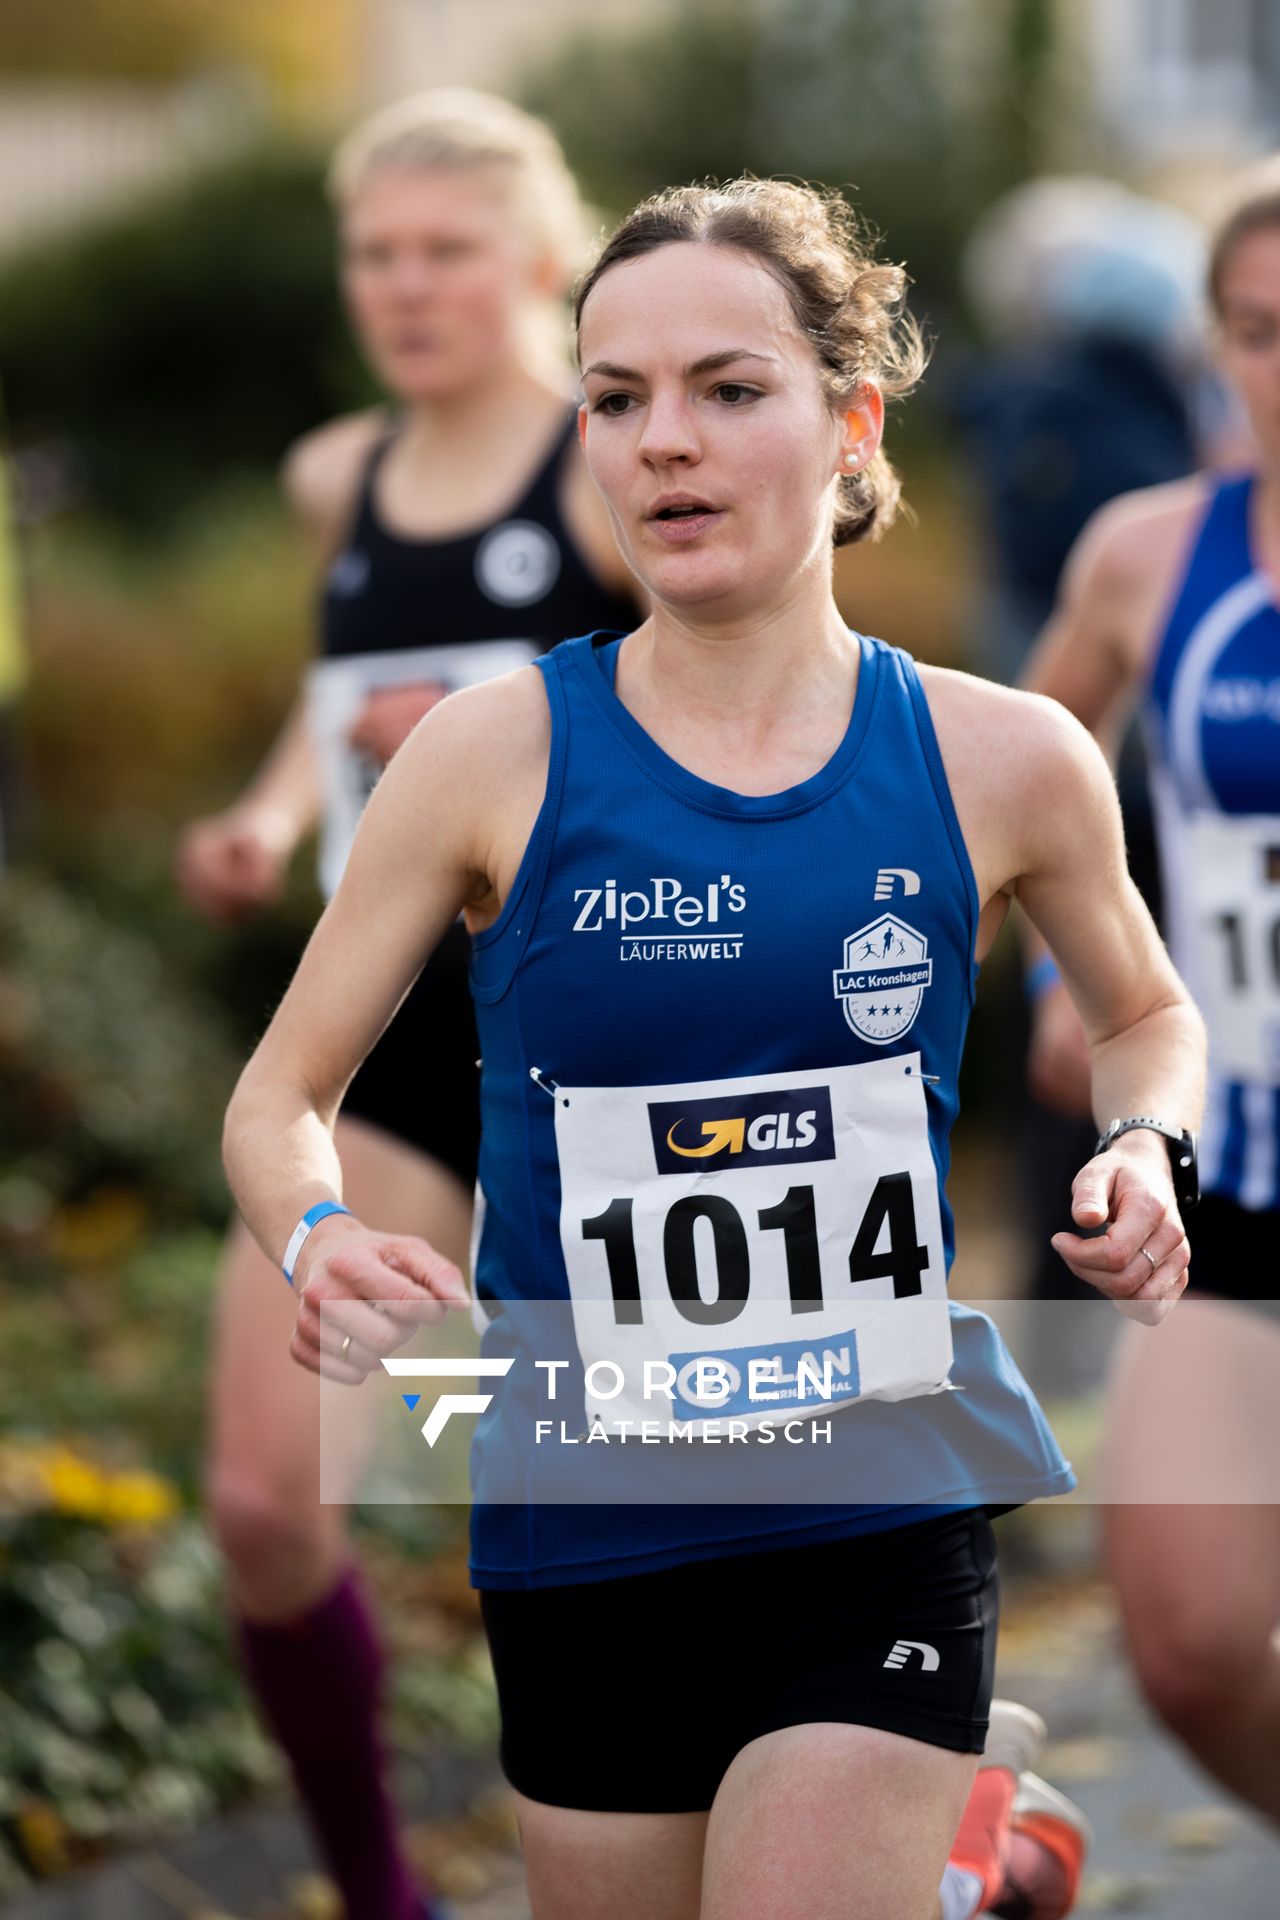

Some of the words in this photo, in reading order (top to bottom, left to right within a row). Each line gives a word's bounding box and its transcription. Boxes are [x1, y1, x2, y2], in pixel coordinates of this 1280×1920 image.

[620, 942, 743, 961] LÄUFERWELT
[839, 977, 866, 990] LAC
[868, 970, 928, 988] Kronshagen
[747, 1110, 817, 1151] GLS
[582, 1171, 930, 1325] 1014
